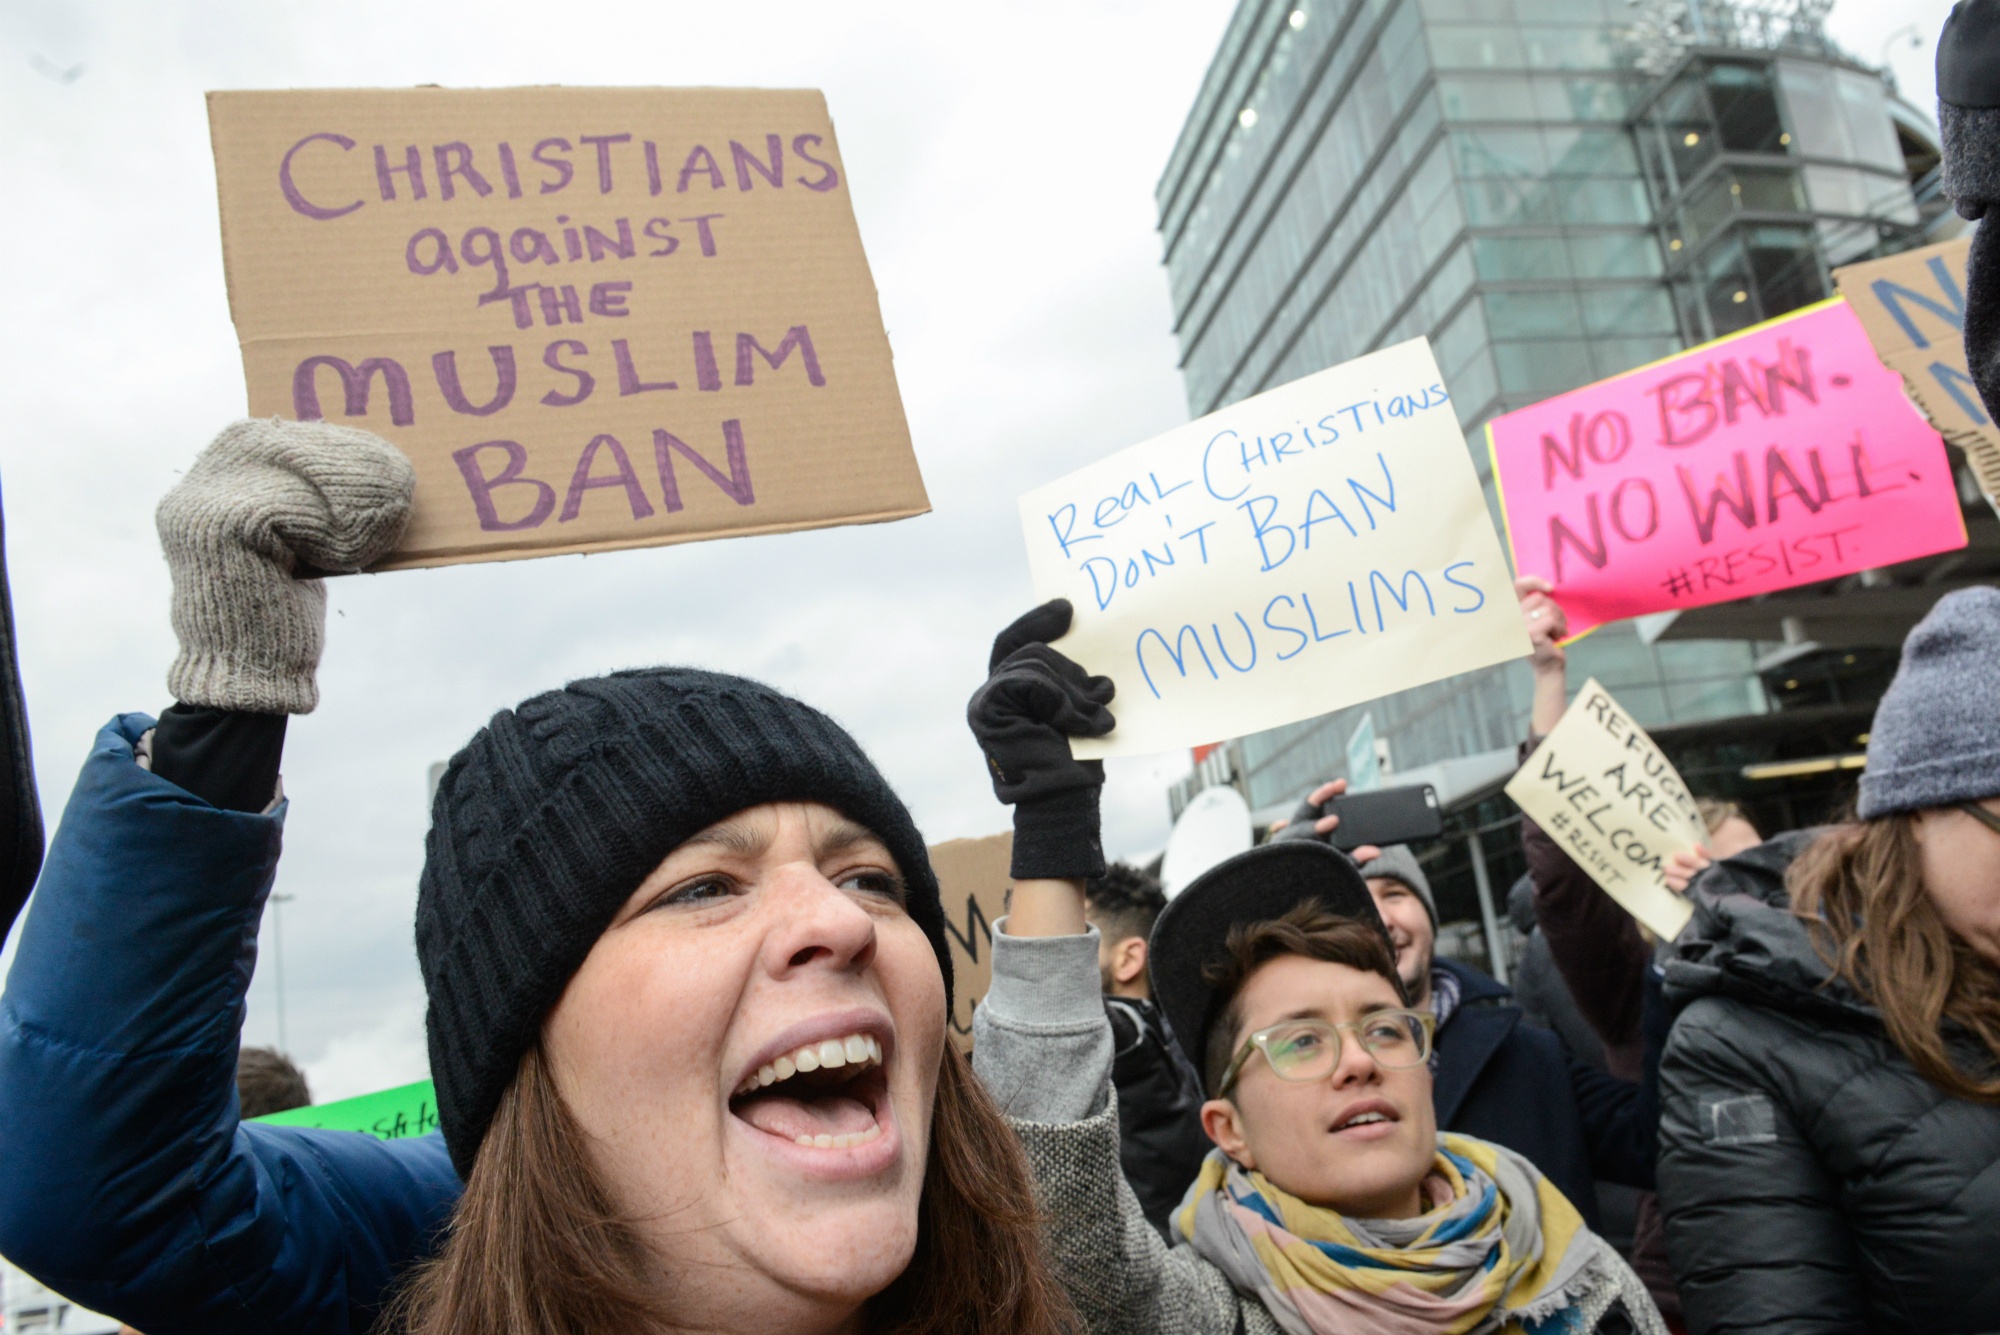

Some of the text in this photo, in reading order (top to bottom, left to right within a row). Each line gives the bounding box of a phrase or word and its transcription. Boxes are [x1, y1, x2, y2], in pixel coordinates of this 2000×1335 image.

[279, 131, 840, 221] CHRISTIANS
[505, 280, 634, 330] THE
[292, 324, 827, 427] MUSLIM
[451, 418, 757, 533] BAN
[1539, 408, 1632, 491] NO
[1236, 452, 1396, 573] BAN
[1547, 477, 1660, 584] NO
[1135, 561, 1486, 700] MUSLIMS
[1585, 692, 1708, 842] REFUGE
[1603, 761, 1680, 833] ARE
[1539, 751, 1683, 900] WELCOM
